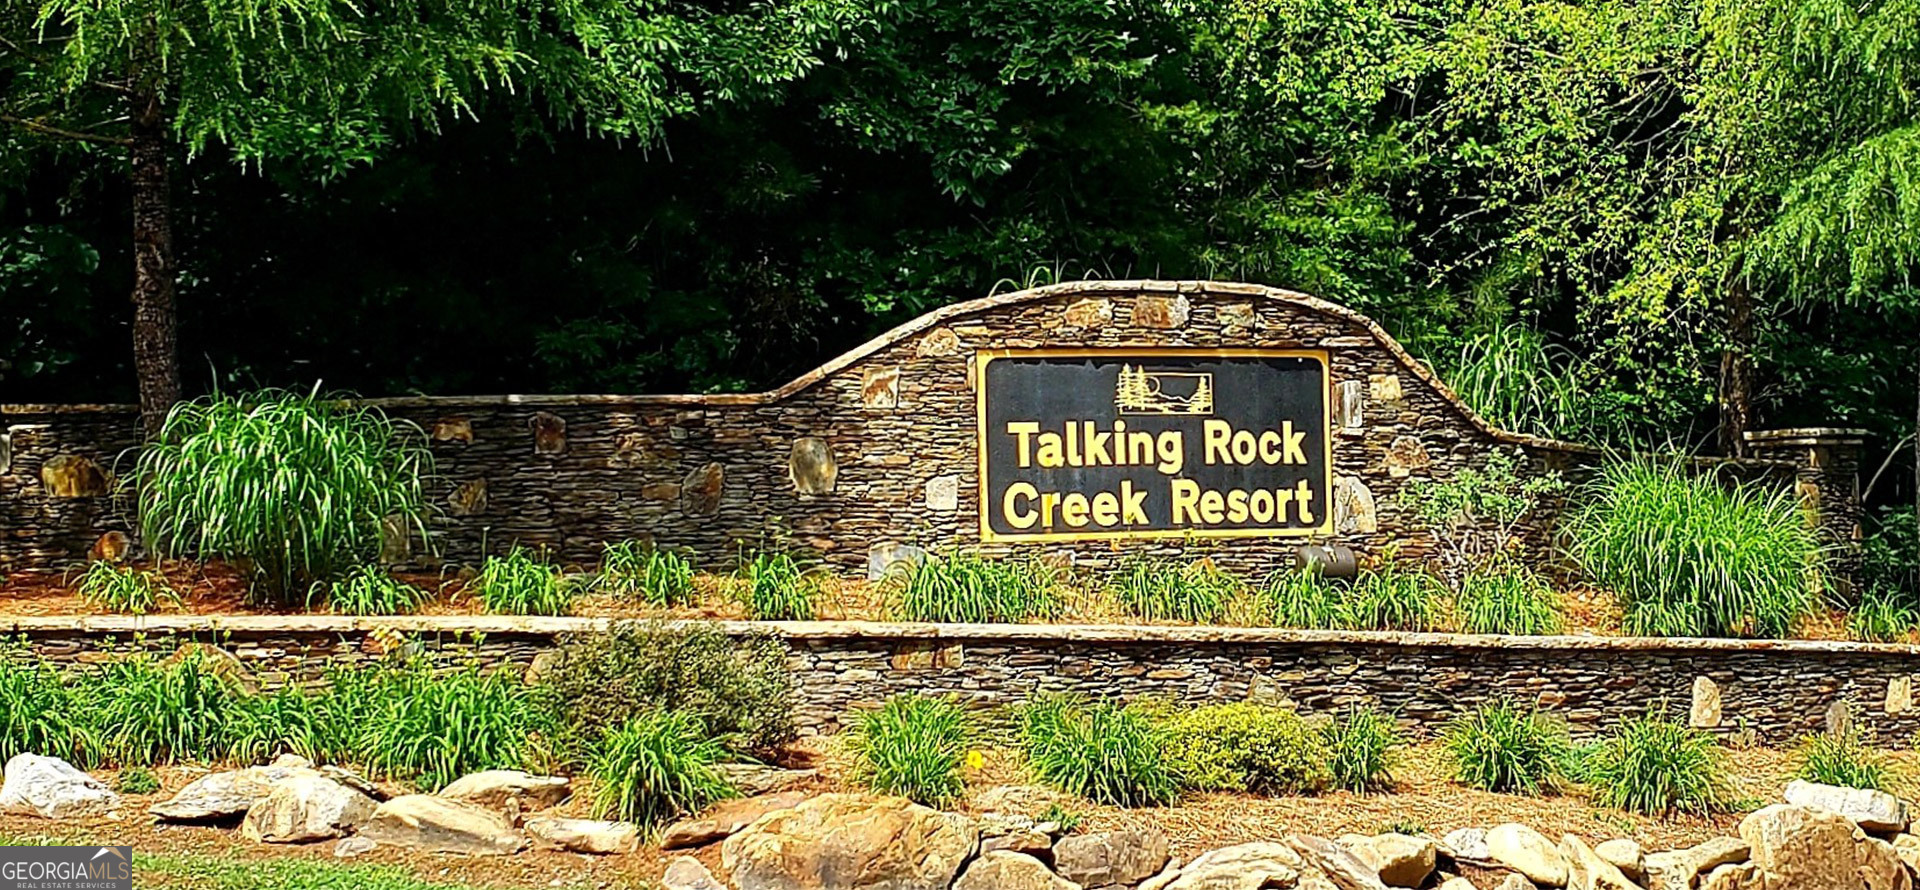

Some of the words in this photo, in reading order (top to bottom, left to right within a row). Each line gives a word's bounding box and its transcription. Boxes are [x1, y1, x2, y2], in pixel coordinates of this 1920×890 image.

[1007, 420, 1184, 475] Talking
[1203, 420, 1308, 465] Rock
[1003, 481, 1150, 529] Creek
[1170, 478, 1315, 525] Resort
